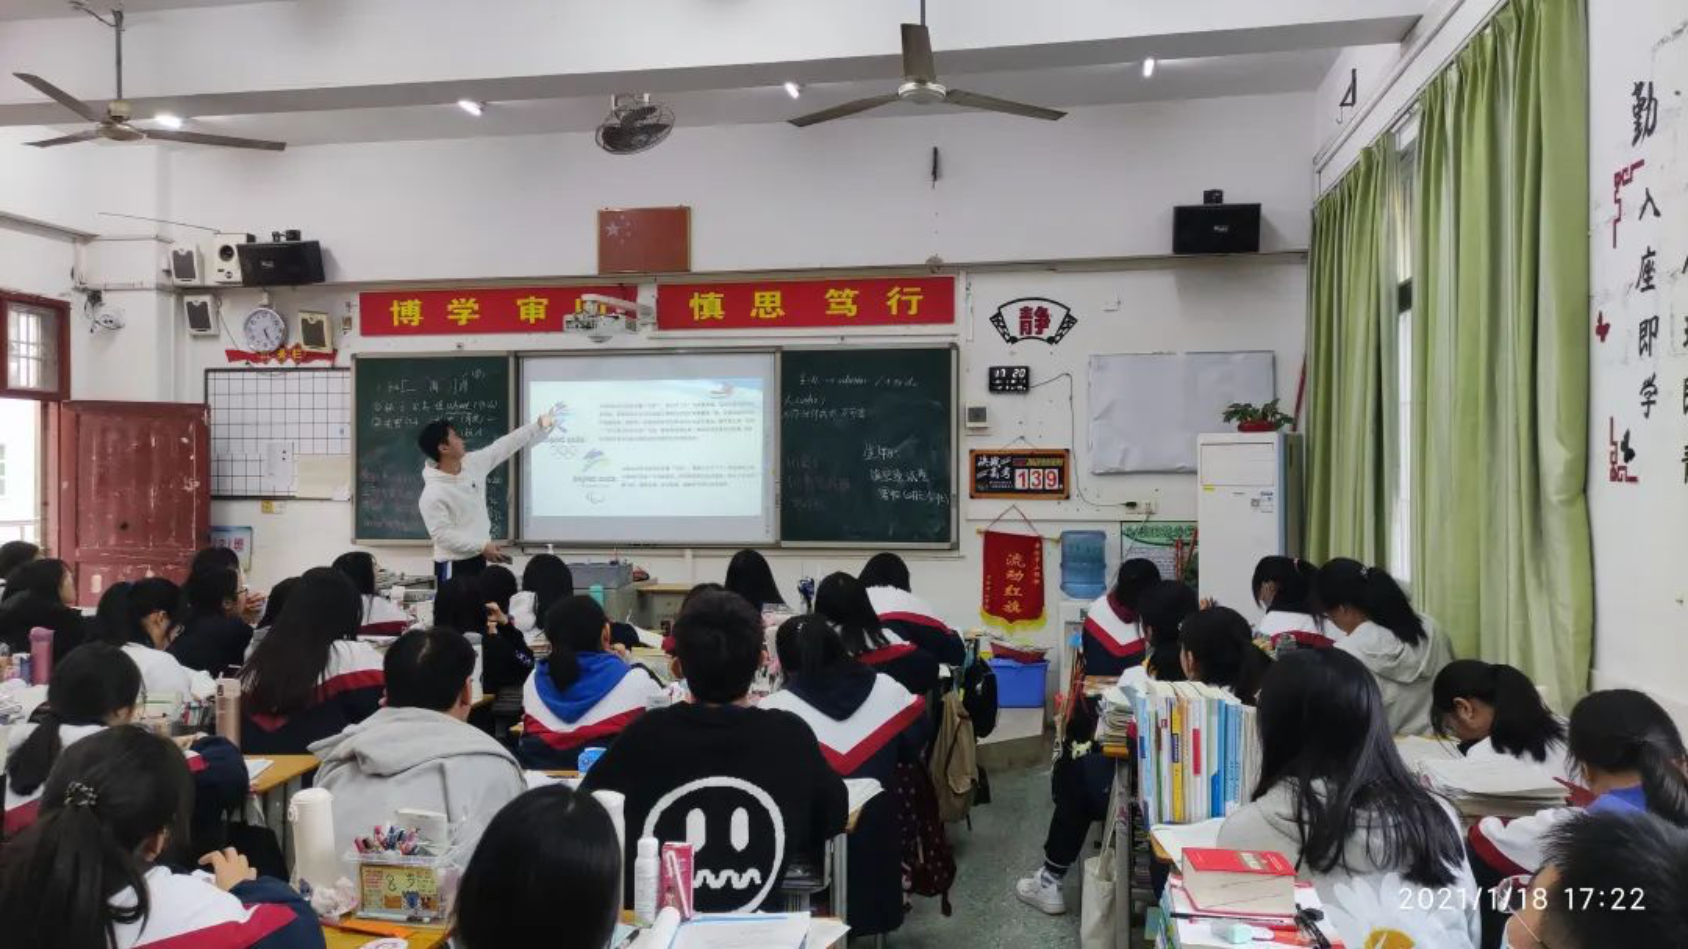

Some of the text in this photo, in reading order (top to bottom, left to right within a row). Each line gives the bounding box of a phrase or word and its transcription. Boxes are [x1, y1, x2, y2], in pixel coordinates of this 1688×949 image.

[1631, 81, 1659, 147] 勤
[689, 286, 923, 321] 慎思笃行
[1019, 306, 1051, 336] 静
[1635, 187, 1662, 419] 入座即学
[1017, 470, 1058, 488] 139
[1002, 552, 1026, 614] 流动红旗
